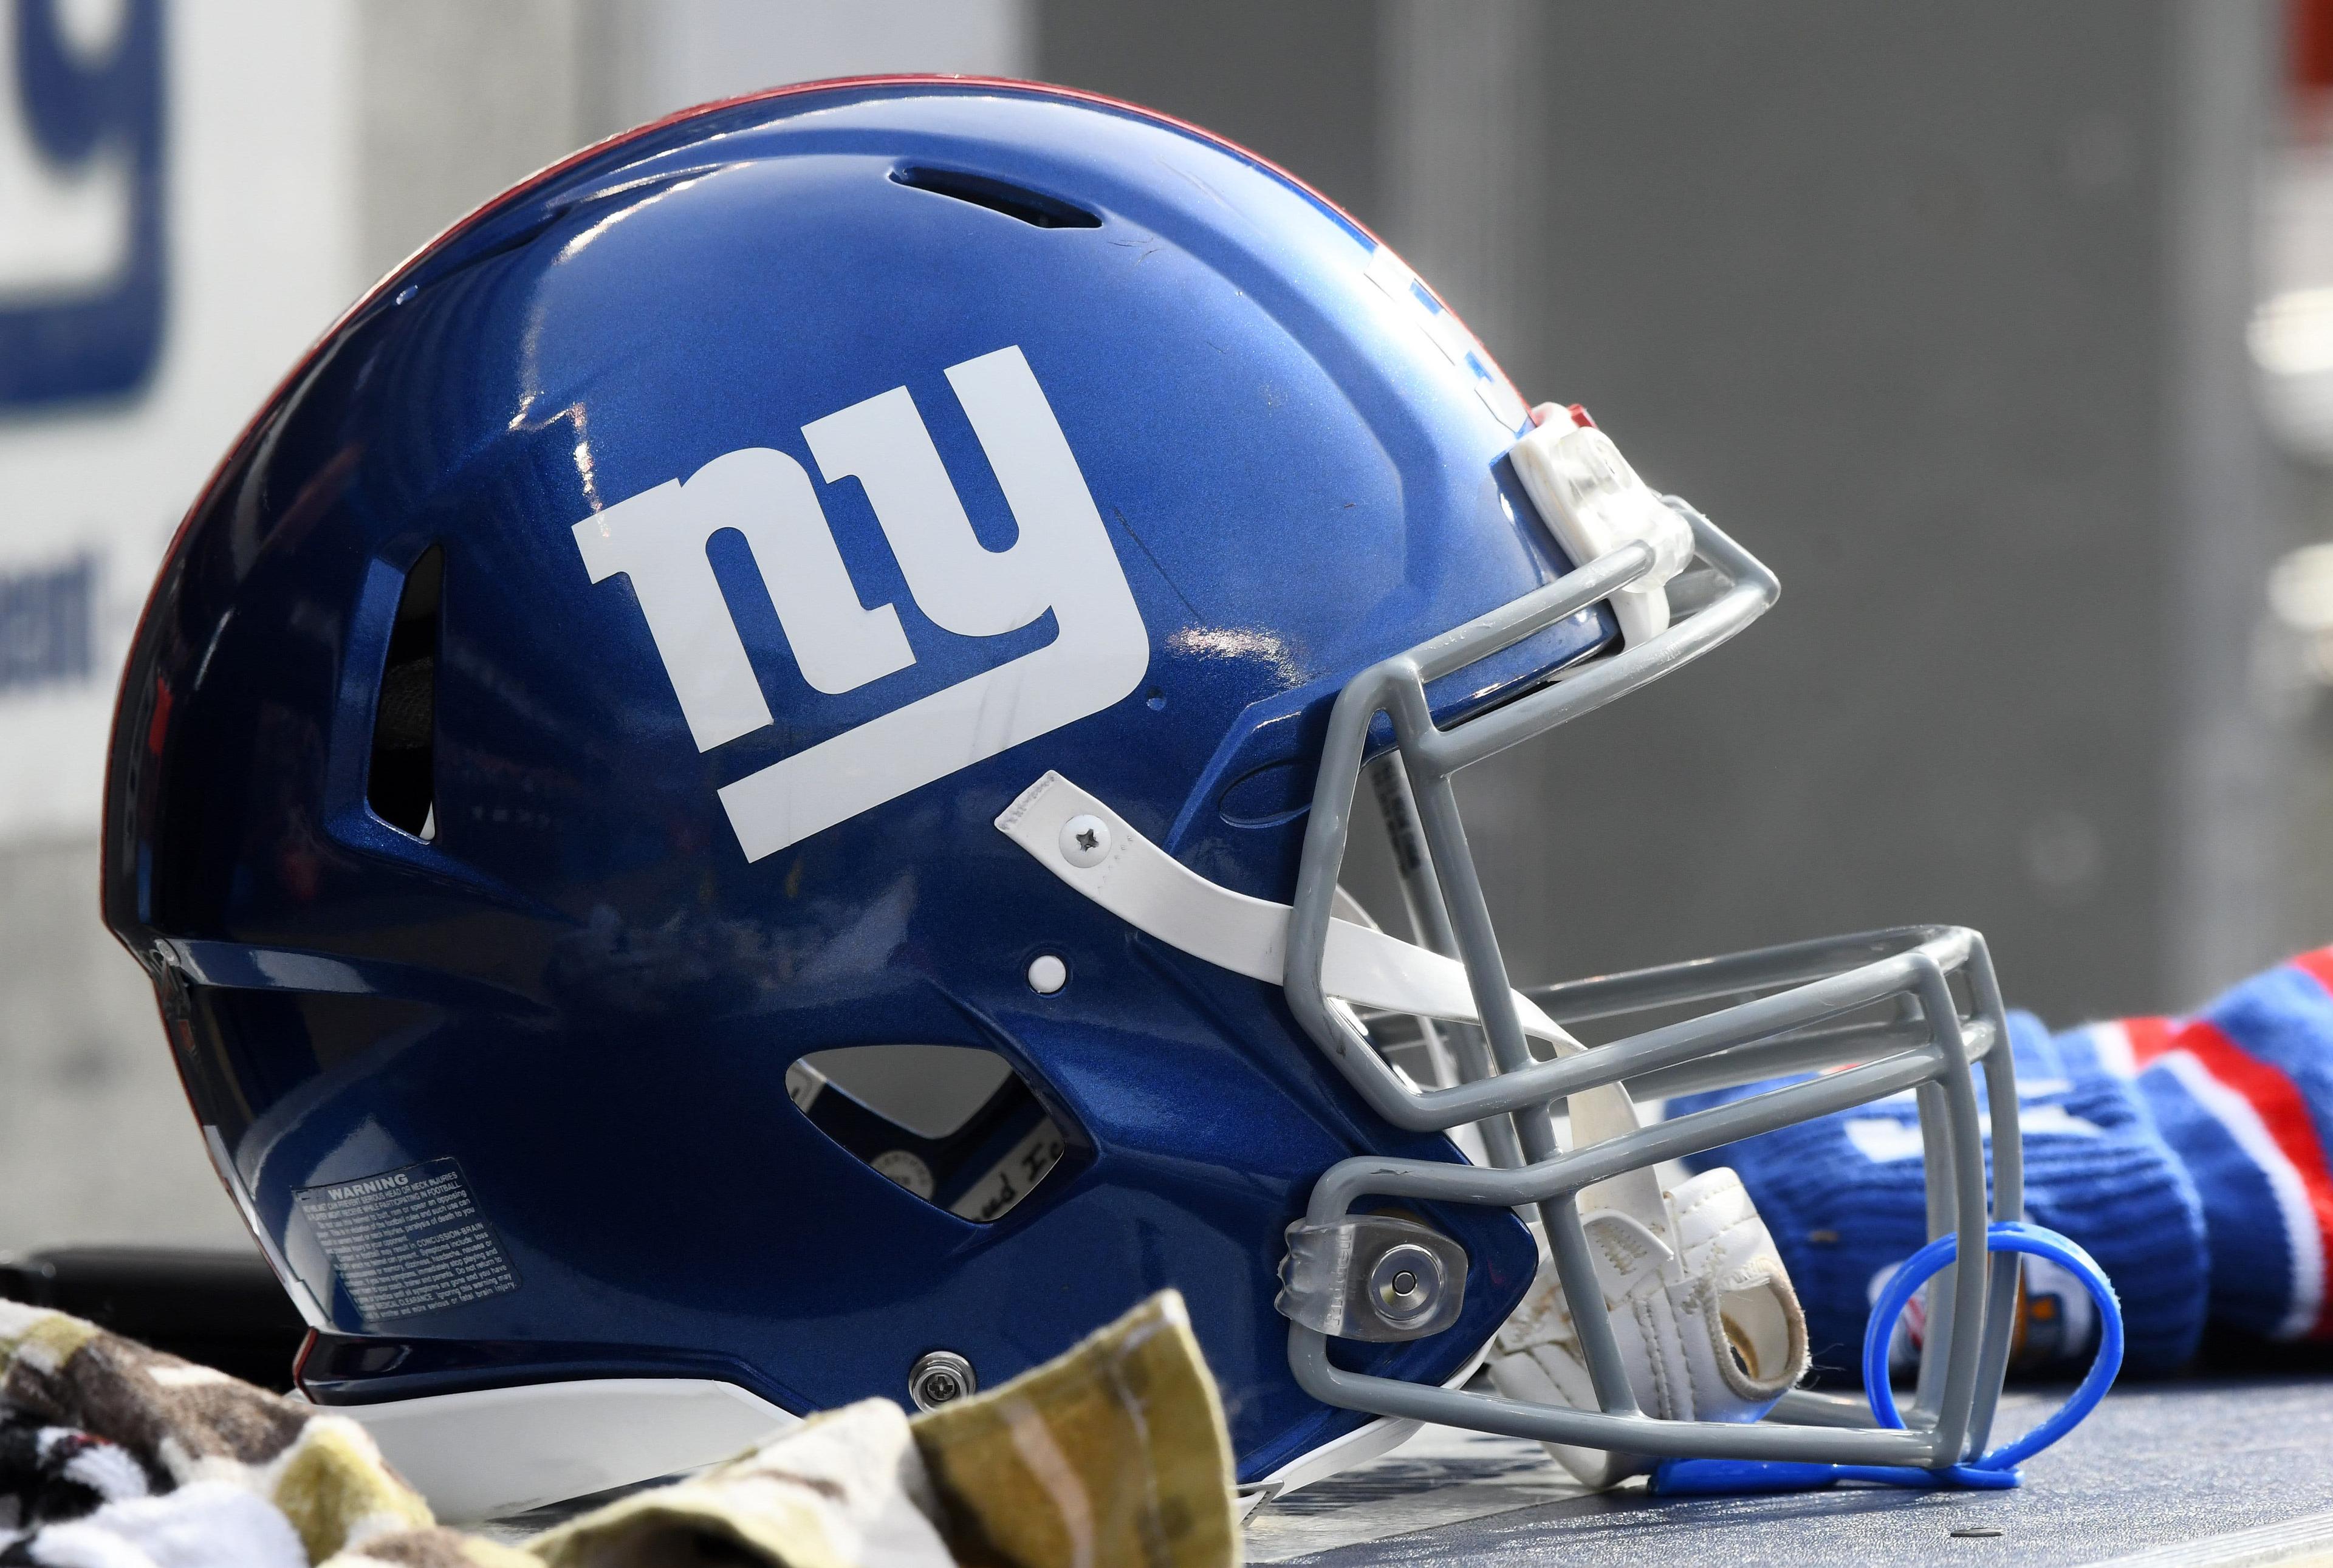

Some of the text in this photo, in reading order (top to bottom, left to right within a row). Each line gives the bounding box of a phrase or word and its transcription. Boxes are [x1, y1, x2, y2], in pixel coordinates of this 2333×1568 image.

[572, 344, 1149, 863] ny
[327, 1173, 409, 1200] WARNING
[383, 1187, 402, 1198] HEAD
[400, 1185, 411, 1194] OR
[436, 1190, 467, 1204] opposing
[462, 1206, 475, 1216] you
[416, 1222, 484, 1247] CONCUSSION-BRAIN
[454, 1266, 466, 1275] Do
[478, 1269, 491, 1279] you
[490, 1264, 507, 1273] have
[474, 1286, 493, 1298] brain
